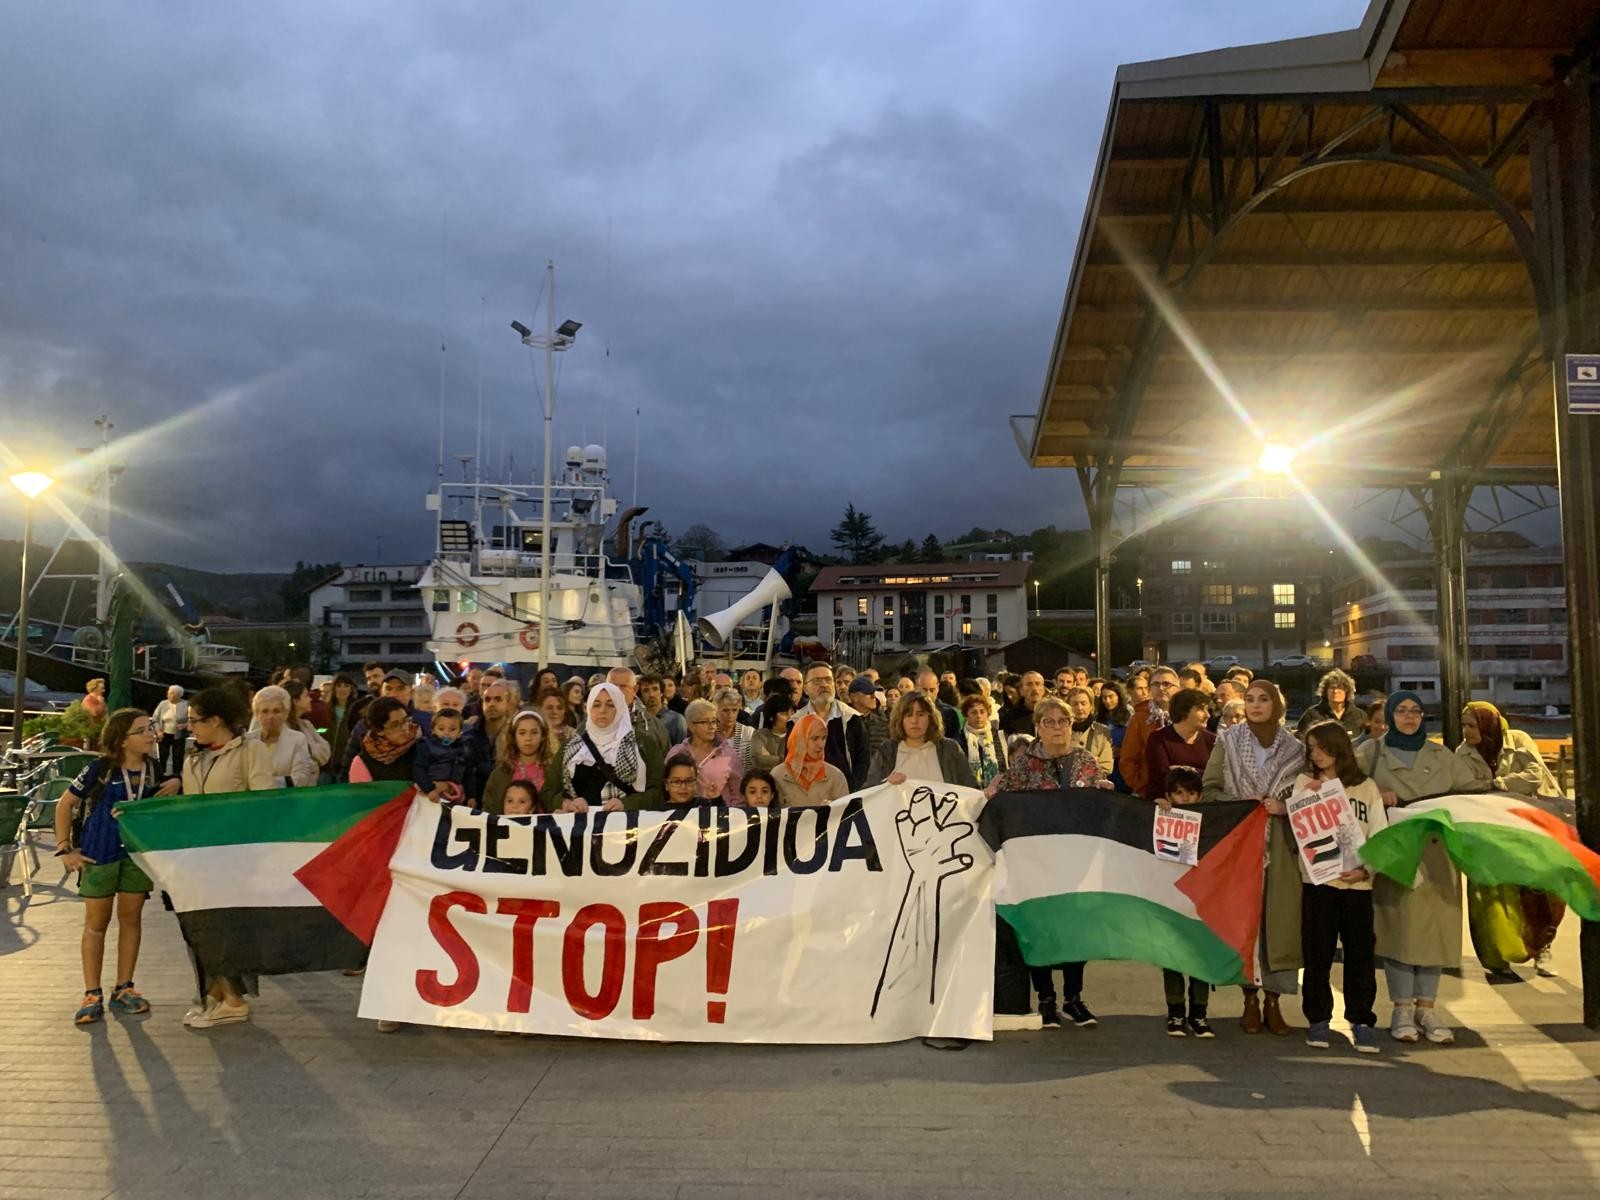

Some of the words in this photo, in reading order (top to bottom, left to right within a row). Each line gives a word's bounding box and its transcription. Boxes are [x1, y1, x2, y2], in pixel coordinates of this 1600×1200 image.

[432, 796, 882, 877] GENOZIDIOA
[1156, 816, 1200, 842] STOP!
[1291, 796, 1350, 840] STOP!
[416, 891, 740, 1023] STOP!
